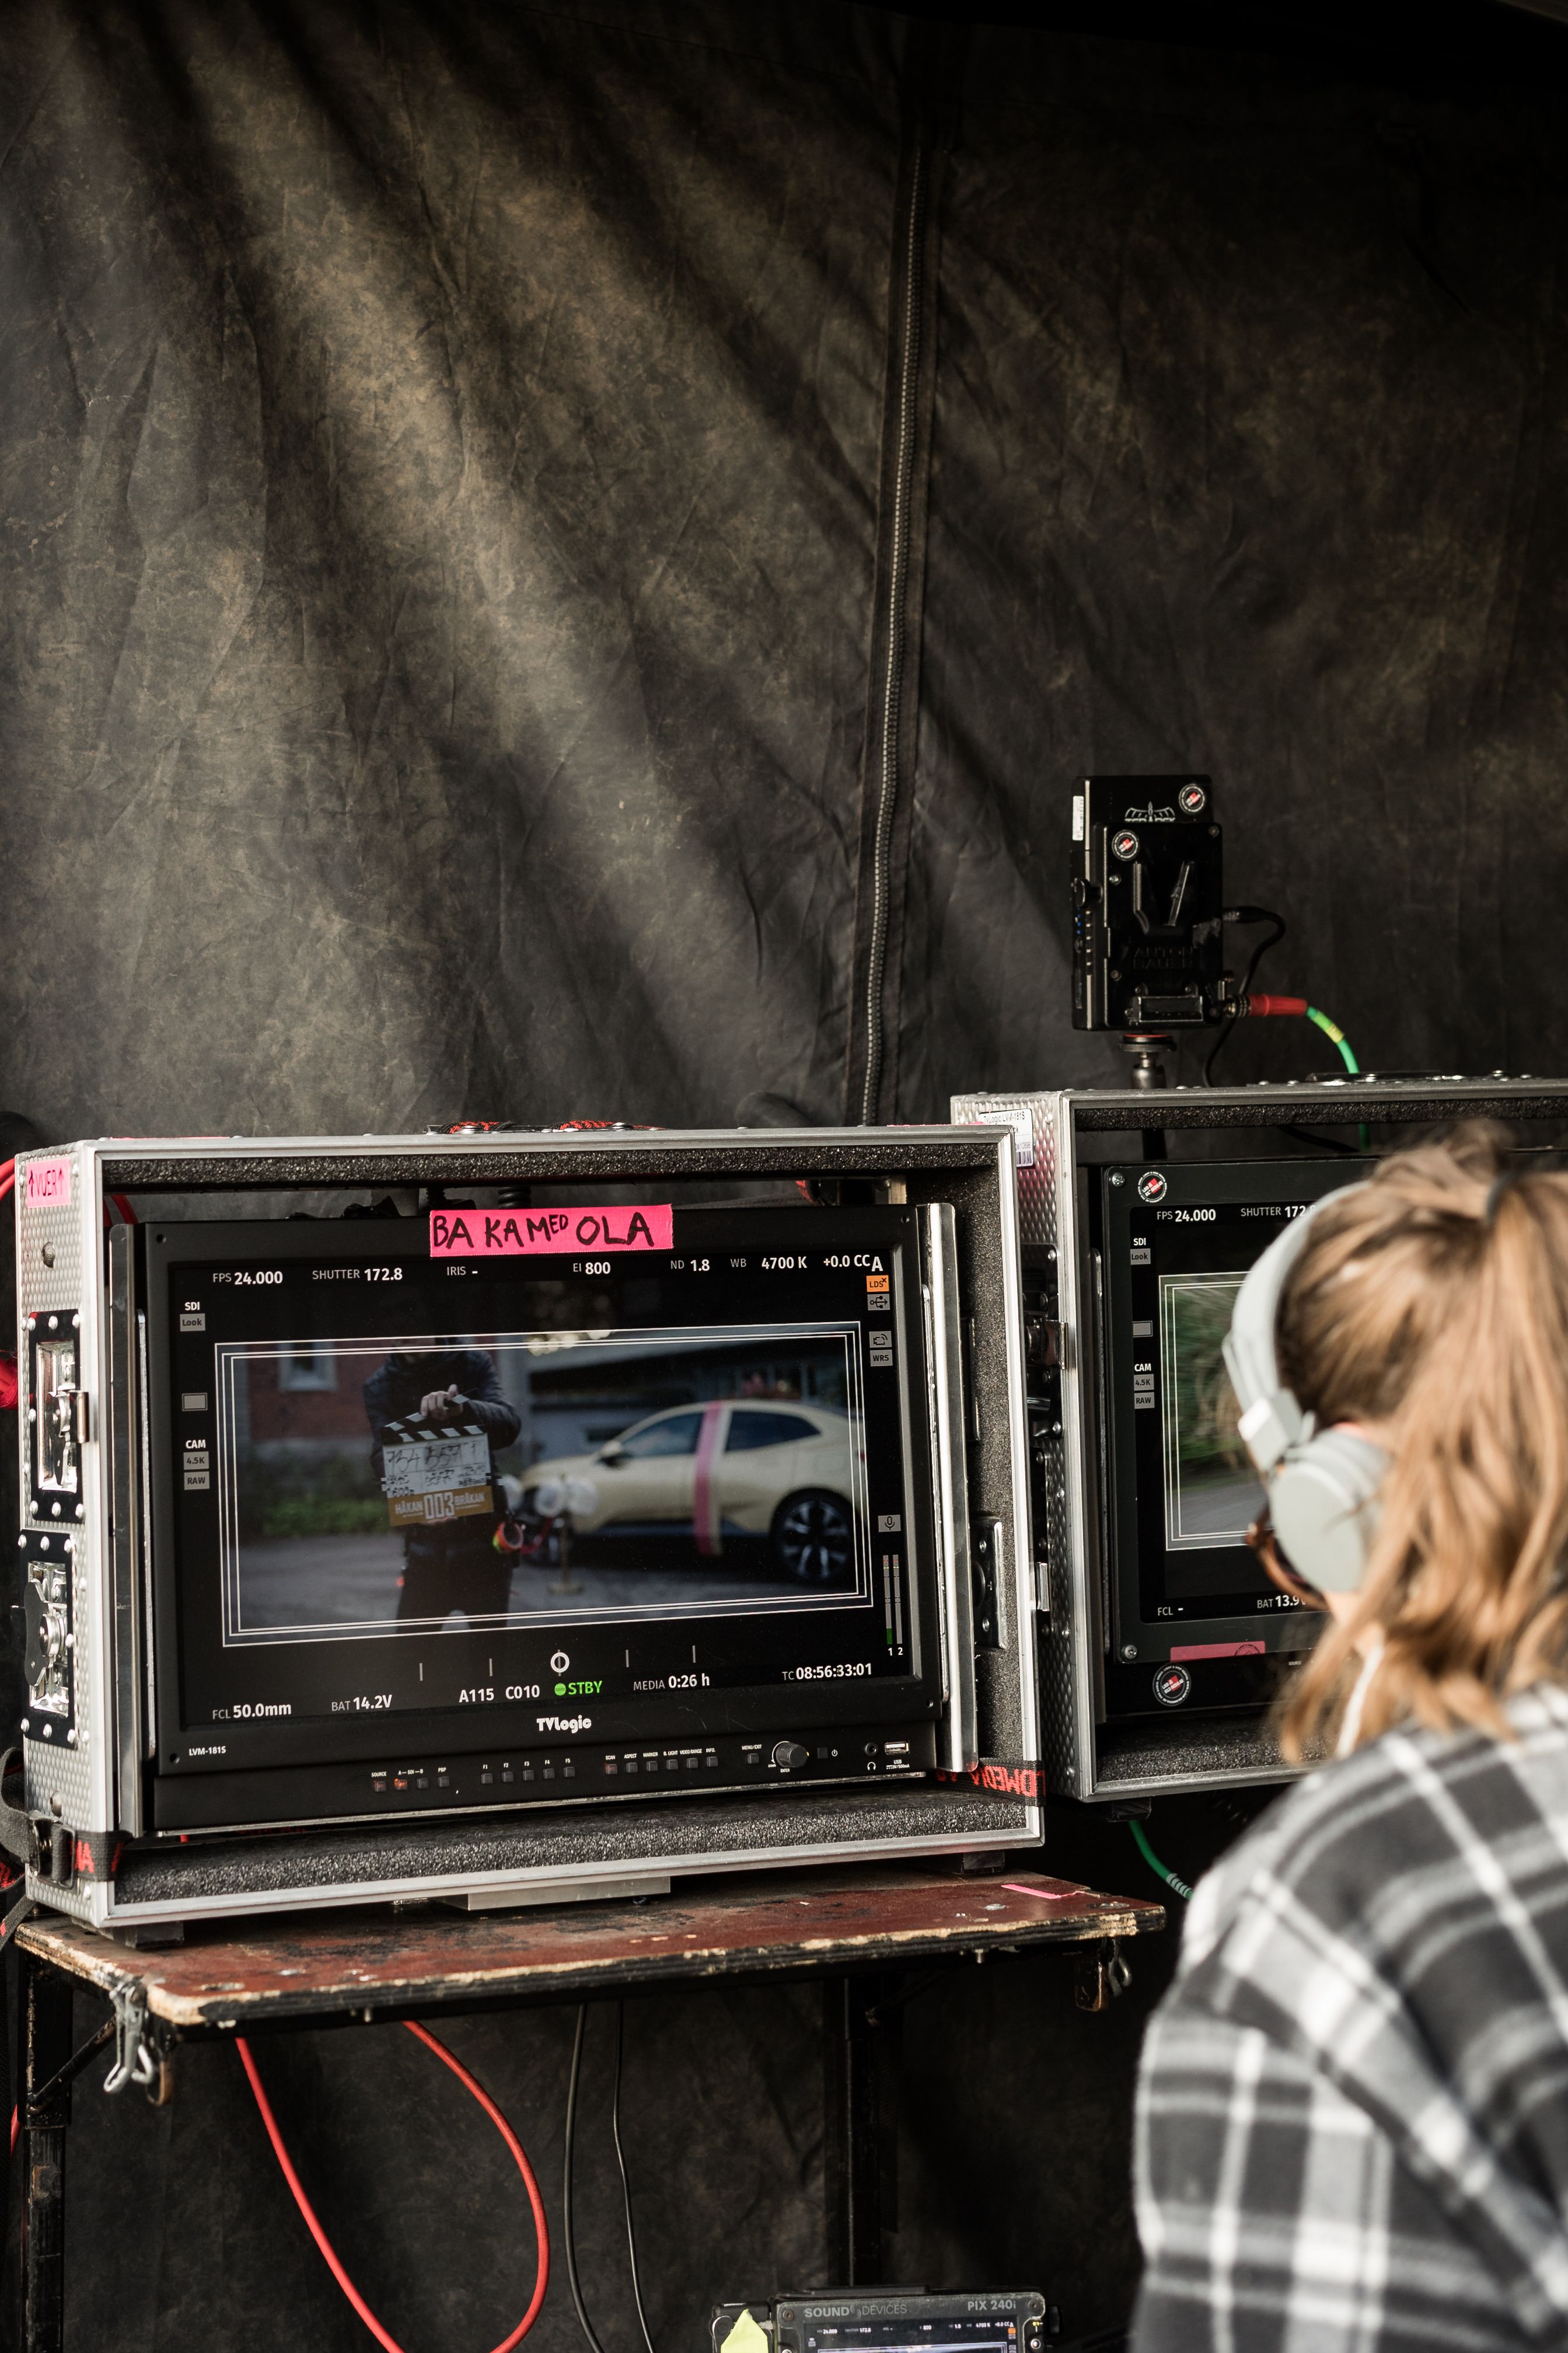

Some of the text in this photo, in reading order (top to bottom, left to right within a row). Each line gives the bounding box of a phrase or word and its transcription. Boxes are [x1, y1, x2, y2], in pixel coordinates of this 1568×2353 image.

[1157, 1209, 1216, 1222] FPS 24.000
[1241, 1205, 1317, 1218] SHUTTER 172
[575, 1211, 655, 1247] OLA
[1133, 1237, 1147, 1246] SDI
[823, 1254, 871, 1267] +0.0 CC
[1131, 1252, 1148, 1260] Look
[573, 1261, 611, 1275] EI 800
[670, 1259, 710, 1271] ND 1.8
[730, 1256, 808, 1270] WB 4700 K
[871, 1256, 883, 1271] A
[312, 1267, 403, 1281] SHUTTER 172.8
[447, 1266, 466, 1276] IRIS
[213, 1271, 283, 1285] FPS 24.000
[184, 1301, 200, 1311] SDI
[182, 1317, 202, 1326] Look
[1134, 1363, 1152, 1372] CAM
[1135, 1378, 1151, 1386] 4.5K
[185, 1439, 206, 1449] CAM
[186, 1456, 205, 1465] 4.5K
[187, 1476, 206, 1485] RAW
[424, 1491, 455, 1519] 003
[1257, 1599, 1273, 1609] BAT
[1157, 1606, 1174, 1616] FCL
[888, 1647, 903, 1656] 1 2
[781, 1663, 872, 1681] TC 08:56:33:01
[568, 1680, 603, 1695] STBY
[633, 1672, 710, 1691] MEDIA 0:26 h
[459, 1685, 540, 1703] A115 C010
[331, 1694, 393, 1711] BAT 14.2V
[212, 1703, 292, 1720] FCL 50.0mm
[536, 1714, 592, 1734] TVLogic
[188, 1745, 226, 1756] LVM-181S
[804, 2303, 907, 2318] SOUND DEVICES
[967, 2298, 1016, 2311] PIX 240i
